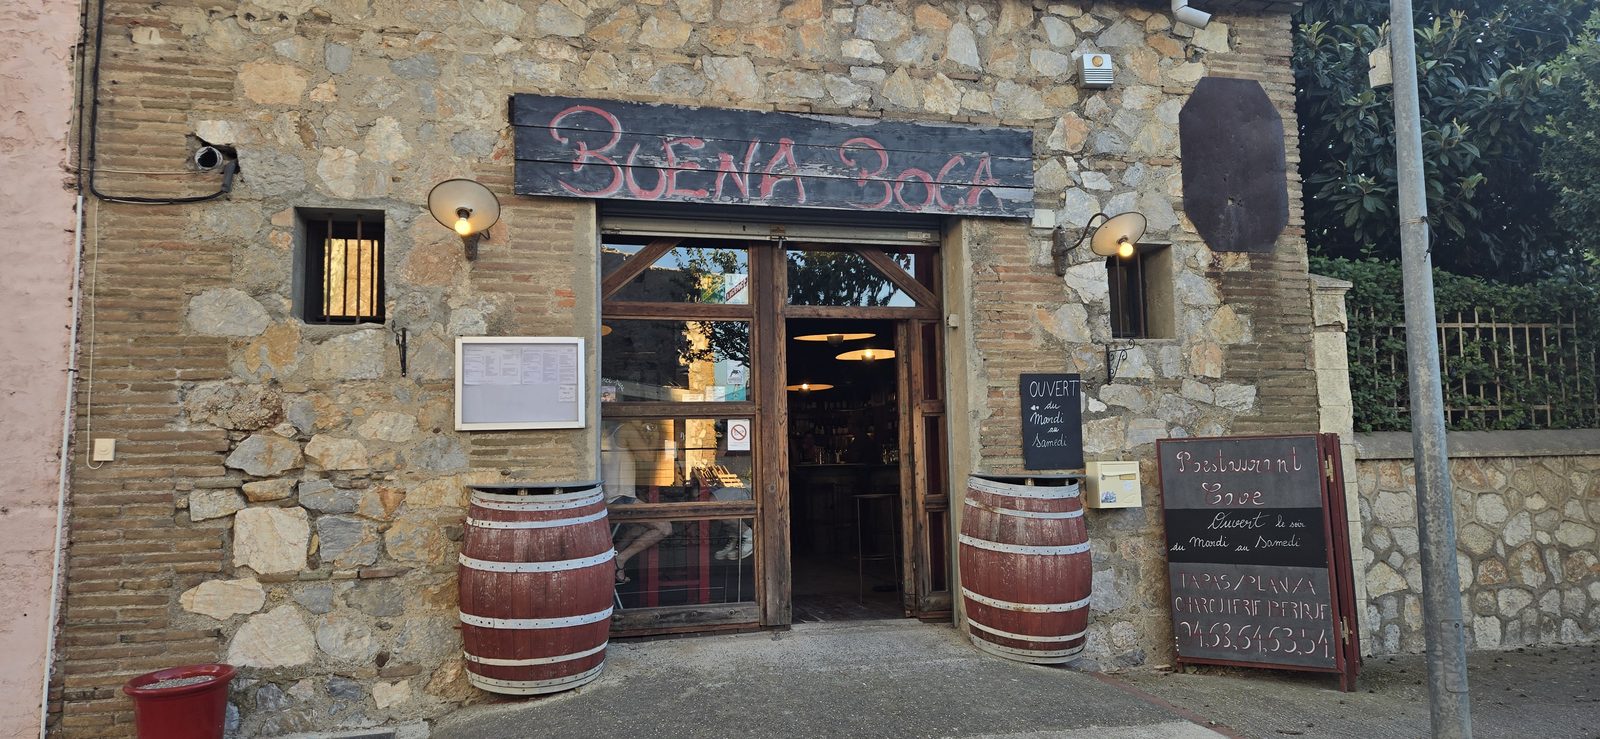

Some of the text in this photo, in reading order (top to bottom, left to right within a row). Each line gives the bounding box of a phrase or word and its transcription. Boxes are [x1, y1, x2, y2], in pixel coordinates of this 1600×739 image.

[550, 106, 1004, 212] BUENA BOCA
[1029, 380, 1079, 398] OUVERT
[1044, 401, 1060, 410] du
[1030, 411, 1065, 426] Mardi
[1032, 433, 1068, 448] Samedi
[1207, 511, 1307, 531] Ouvert le soir
[1170, 534, 1301, 552] du Mardi au Samedi
